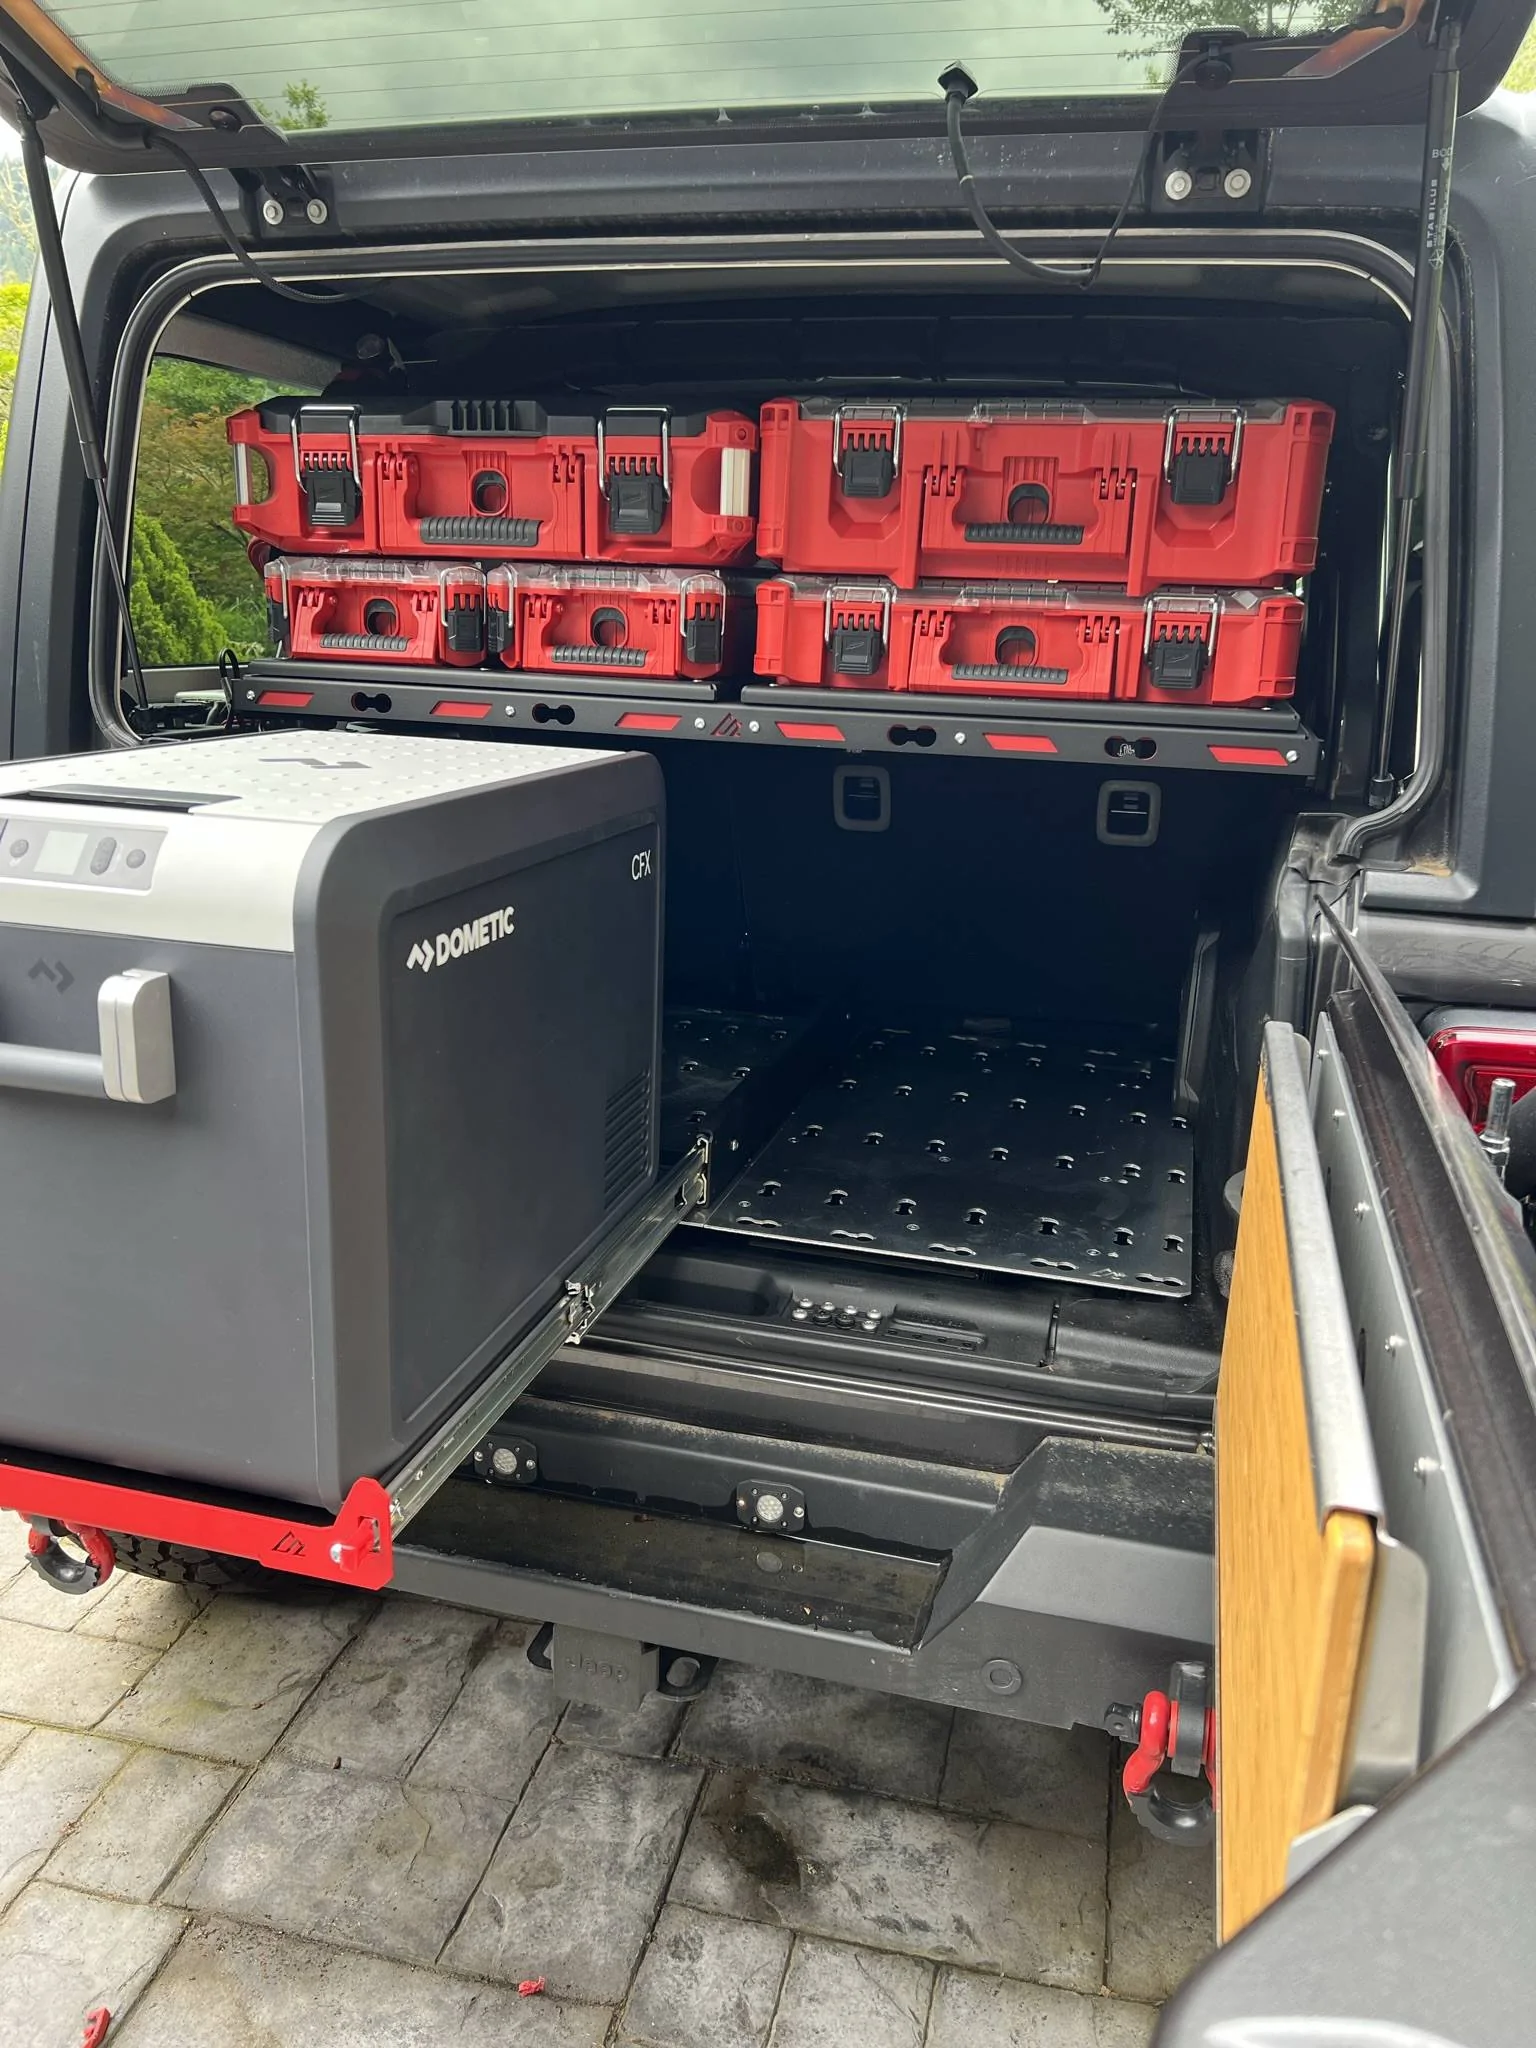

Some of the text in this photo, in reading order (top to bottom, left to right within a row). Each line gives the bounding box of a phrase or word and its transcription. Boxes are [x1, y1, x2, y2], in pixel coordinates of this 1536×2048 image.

[1426, 178, 1437, 248] STABILUS
[631, 850, 651, 881] CFX
[436, 906, 515, 967] DOMETIC
[566, 1653, 629, 1683] Jeep
